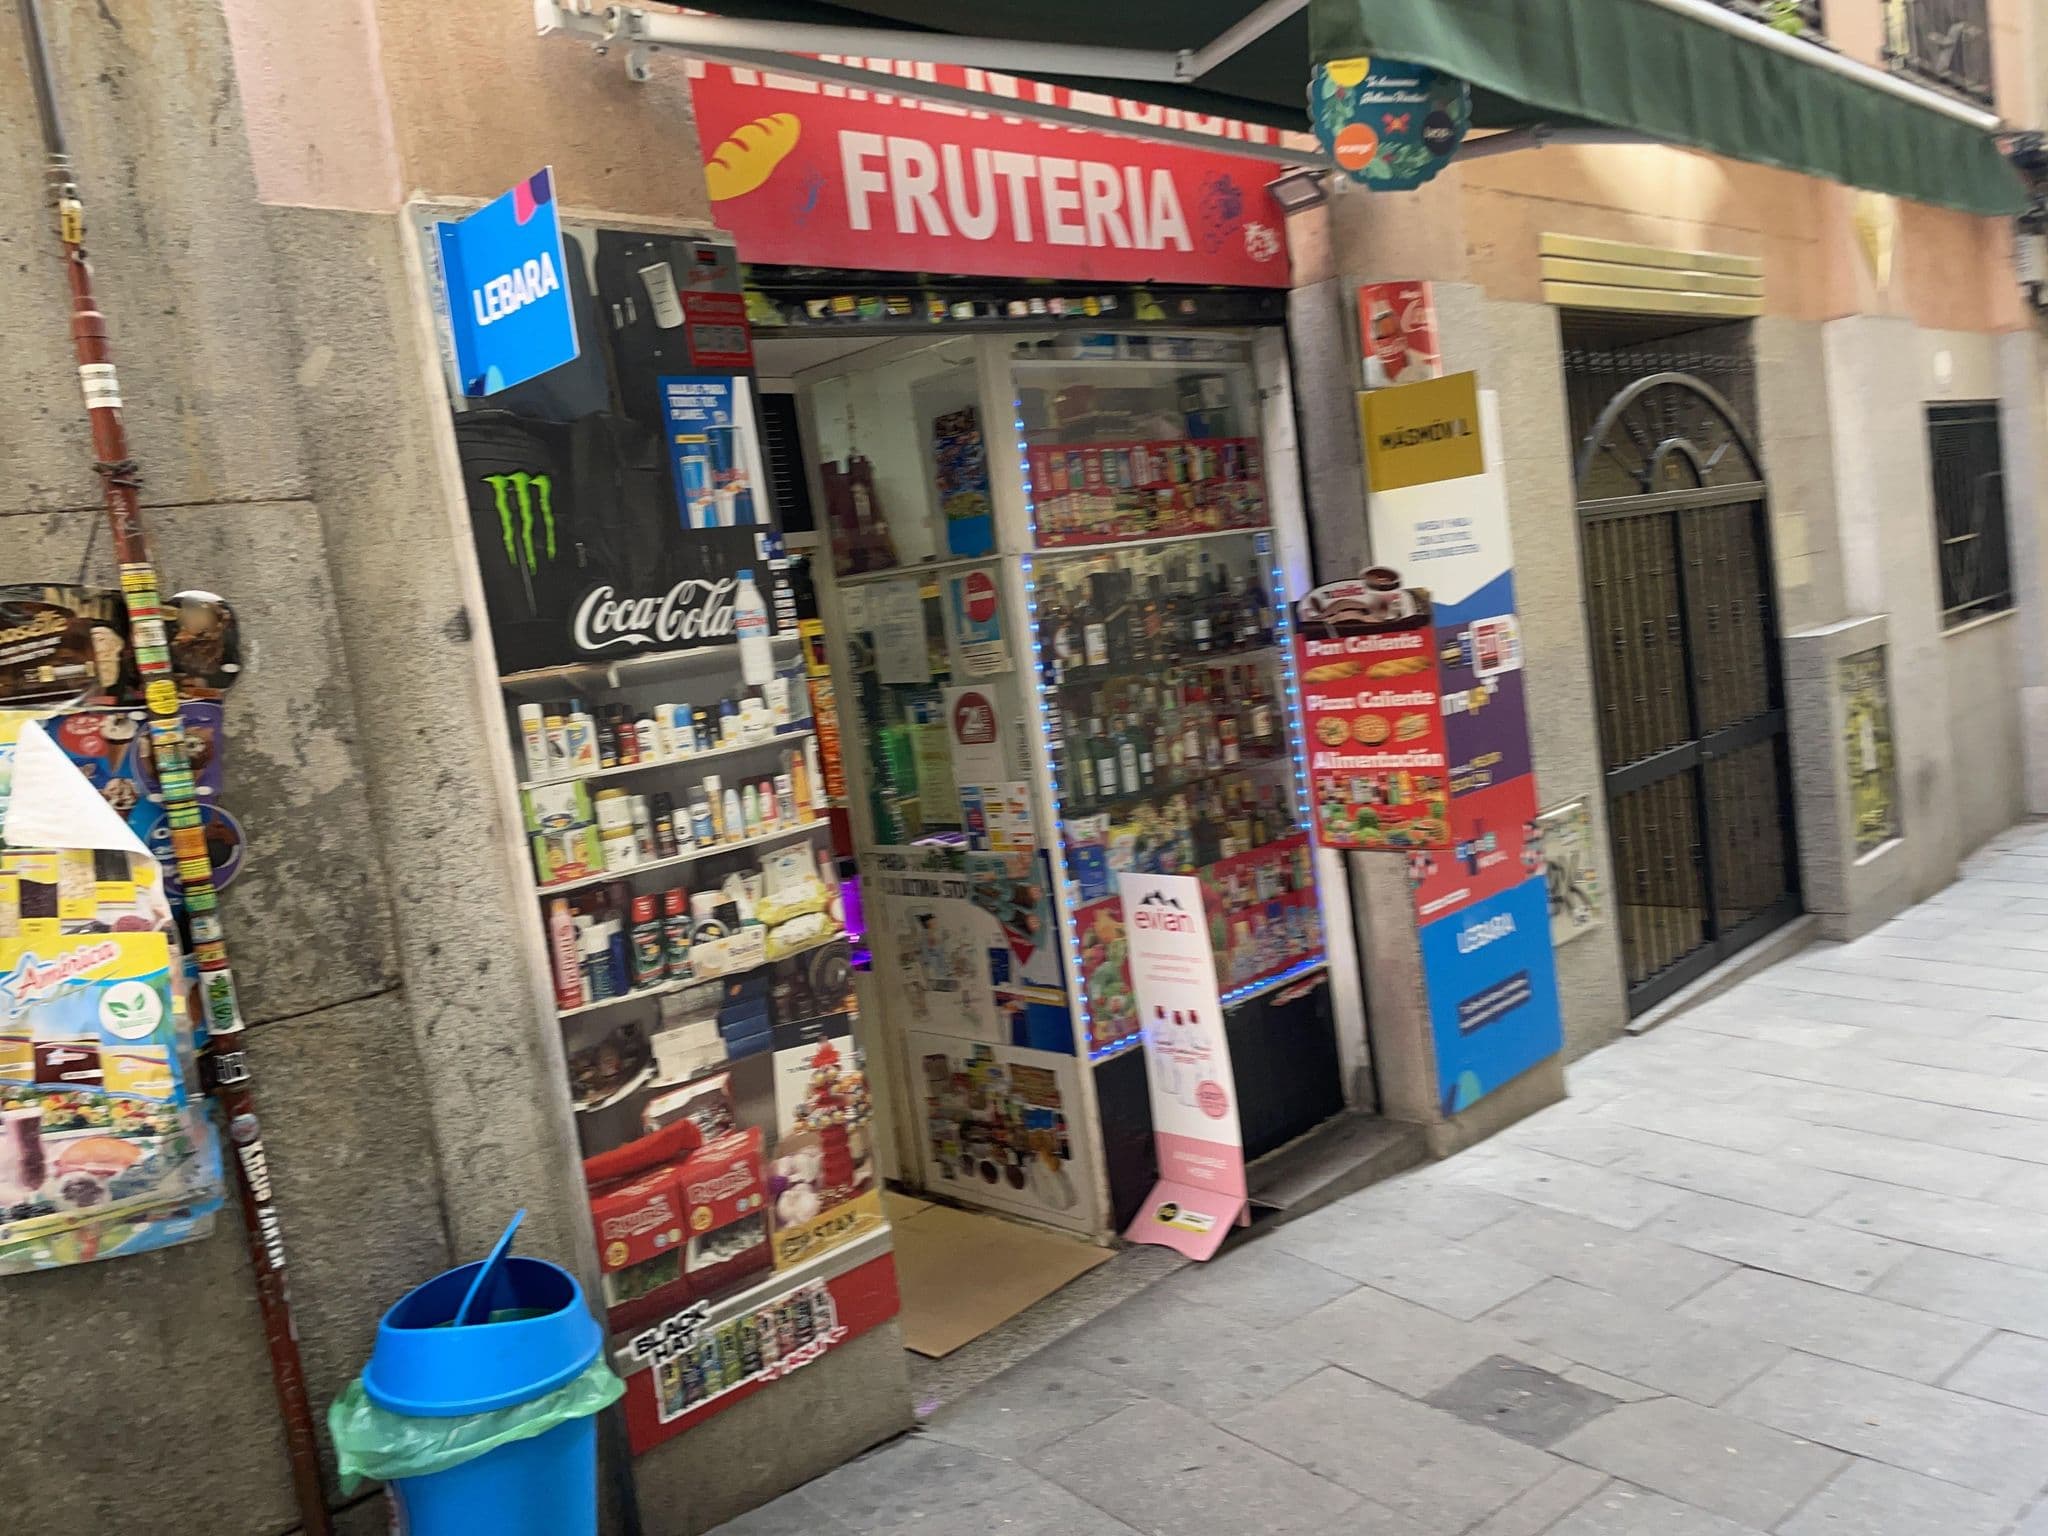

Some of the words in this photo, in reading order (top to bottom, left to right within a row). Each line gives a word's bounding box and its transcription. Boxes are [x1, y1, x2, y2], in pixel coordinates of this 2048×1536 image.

[838, 130, 1193, 252] FRUTERIA
[472, 251, 560, 326] LEBARA
[574, 577, 738, 650] Coca-Cola
[1305, 640, 1344, 656] Pan
[1345, 634, 1423, 653] Caliente
[1356, 690, 1436, 708] Caliente
[1134, 908, 1195, 933] evian
[655, 1329, 694, 1363] HAT
